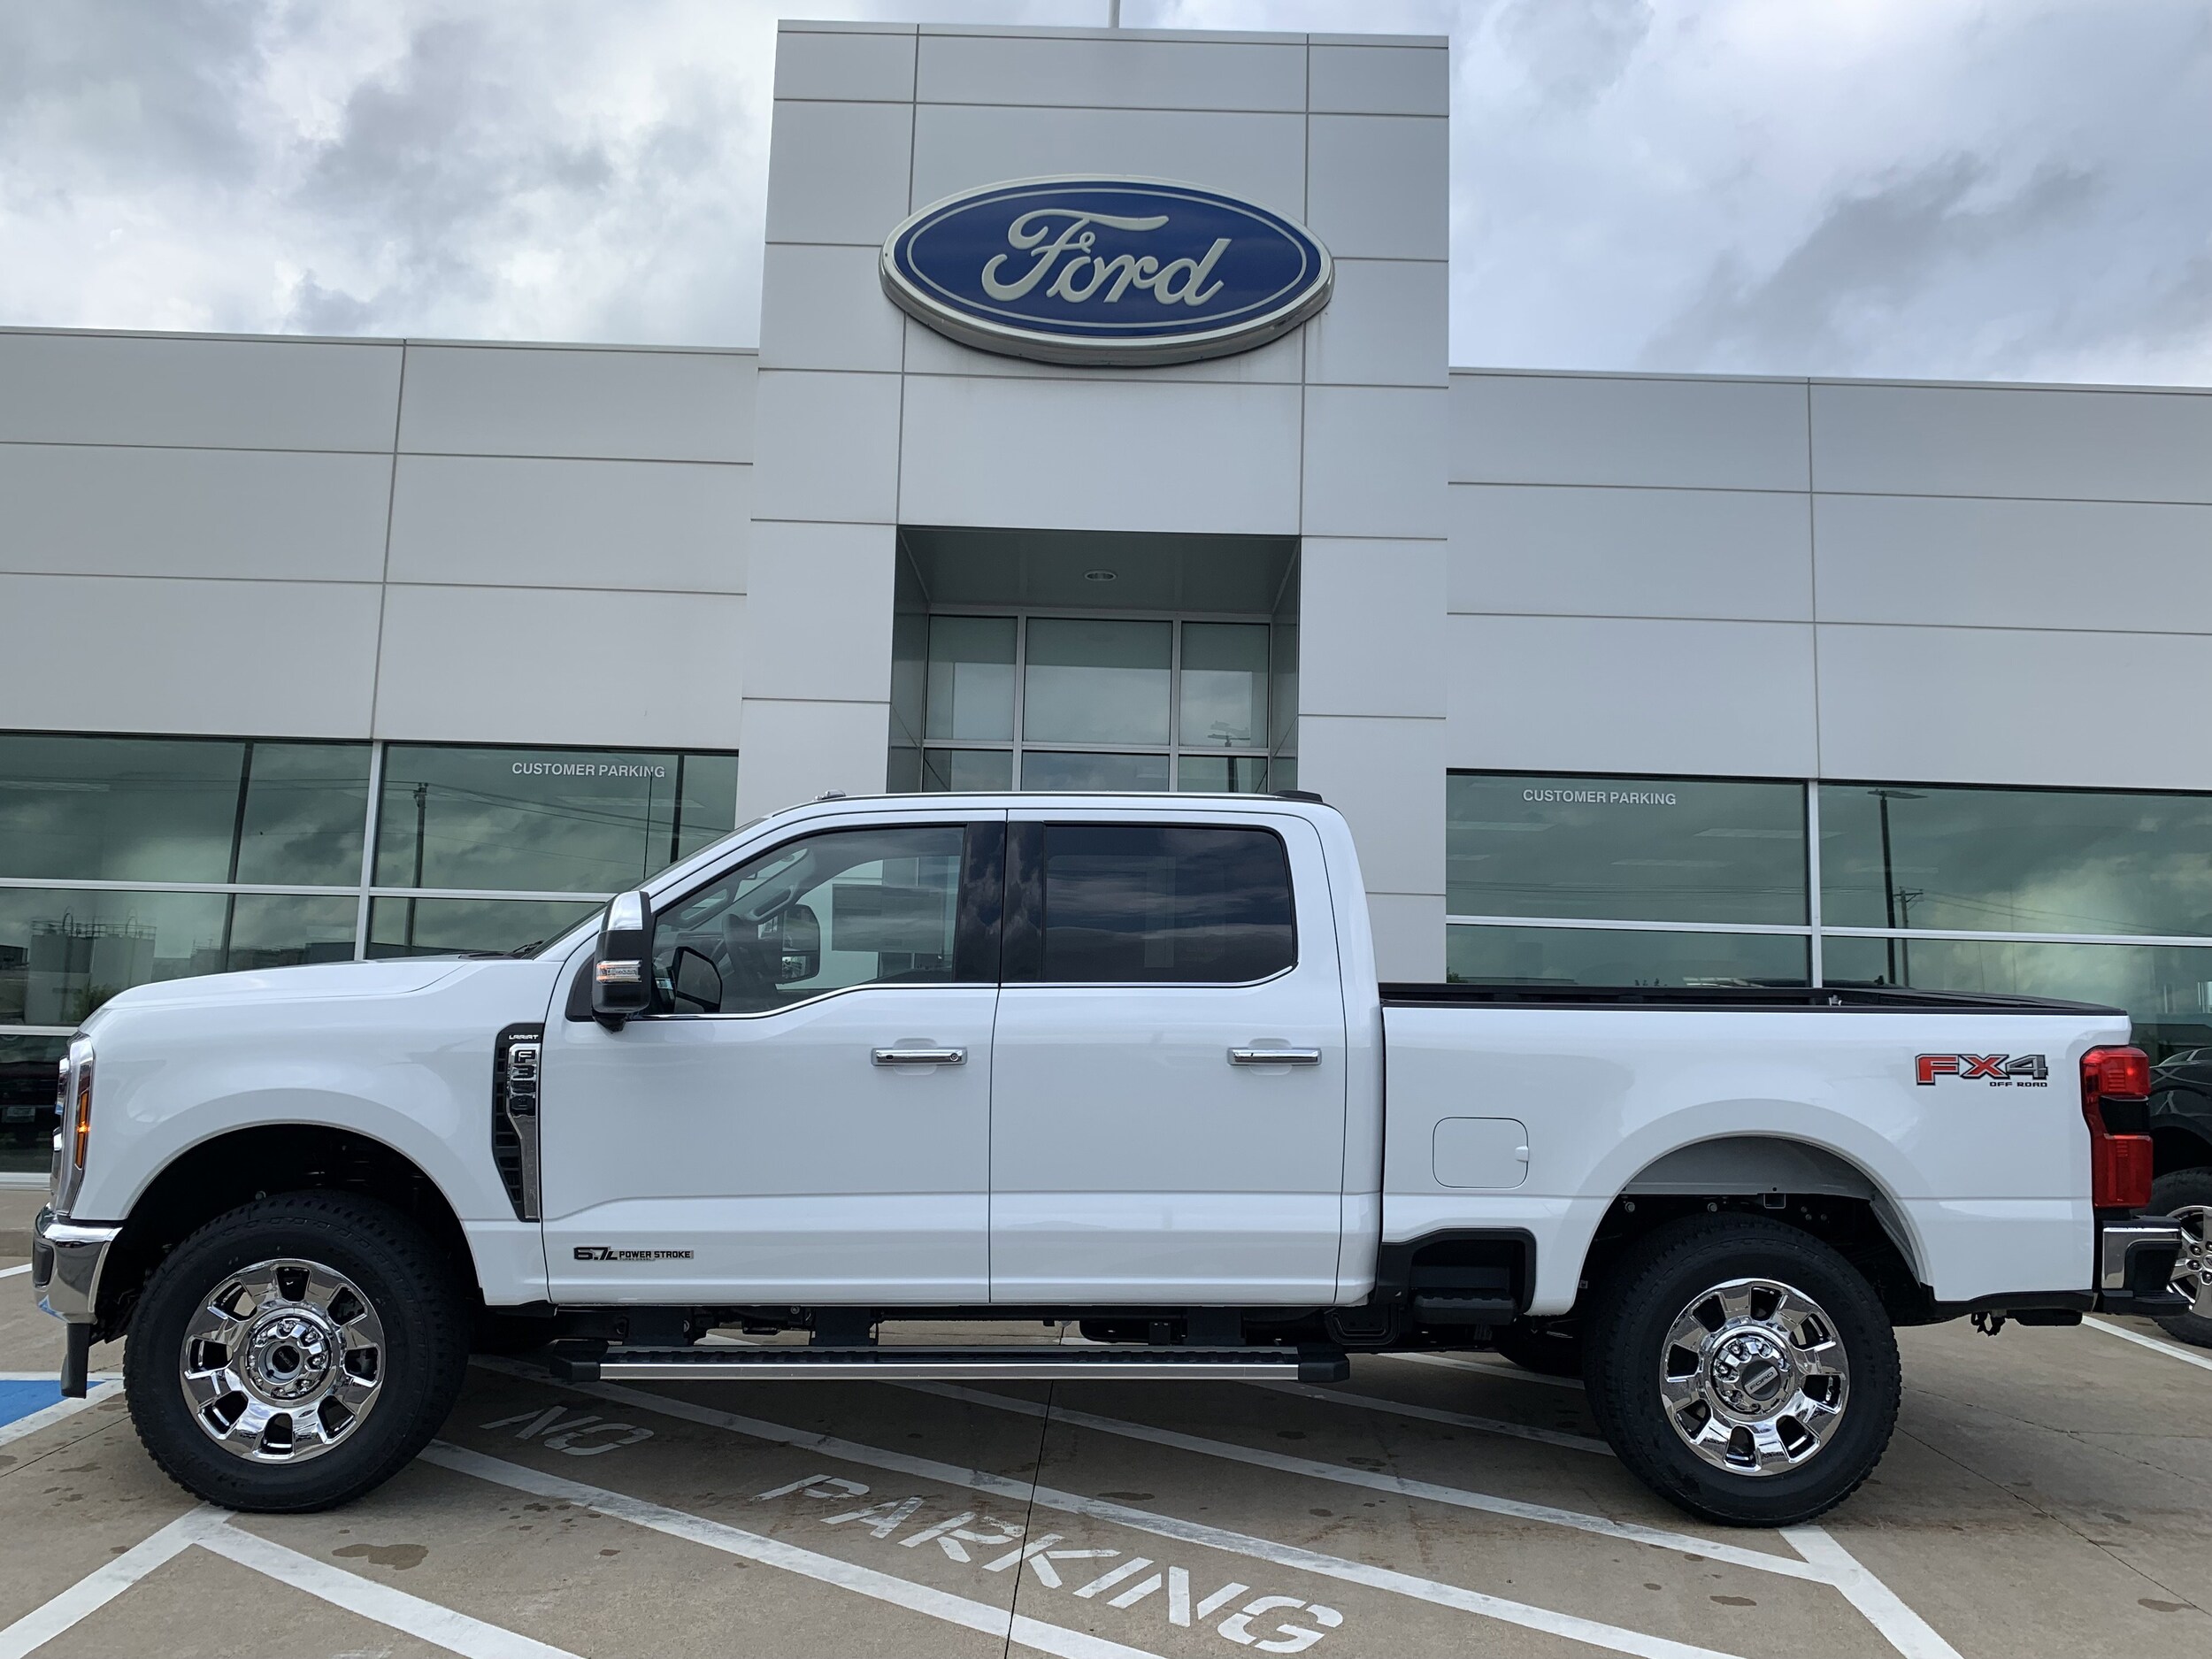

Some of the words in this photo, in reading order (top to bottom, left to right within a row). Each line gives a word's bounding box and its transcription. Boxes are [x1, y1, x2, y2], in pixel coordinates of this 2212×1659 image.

[981, 208, 1232, 306] Ford
[511, 762, 595, 776] CUSTOMER
[598, 764, 665, 778] PARKING
[1523, 789, 1606, 803] CUSTOMER
[1609, 791, 1677, 805] PARKING
[1915, 1053, 2049, 1086] FX4
[619, 1250, 652, 1259] POWER
[654, 1250, 691, 1259] STROKE
[1749, 1371, 1774, 1390] FORD
[479, 1405, 654, 1455] NO
[749, 1473, 1343, 1653] PARKING
